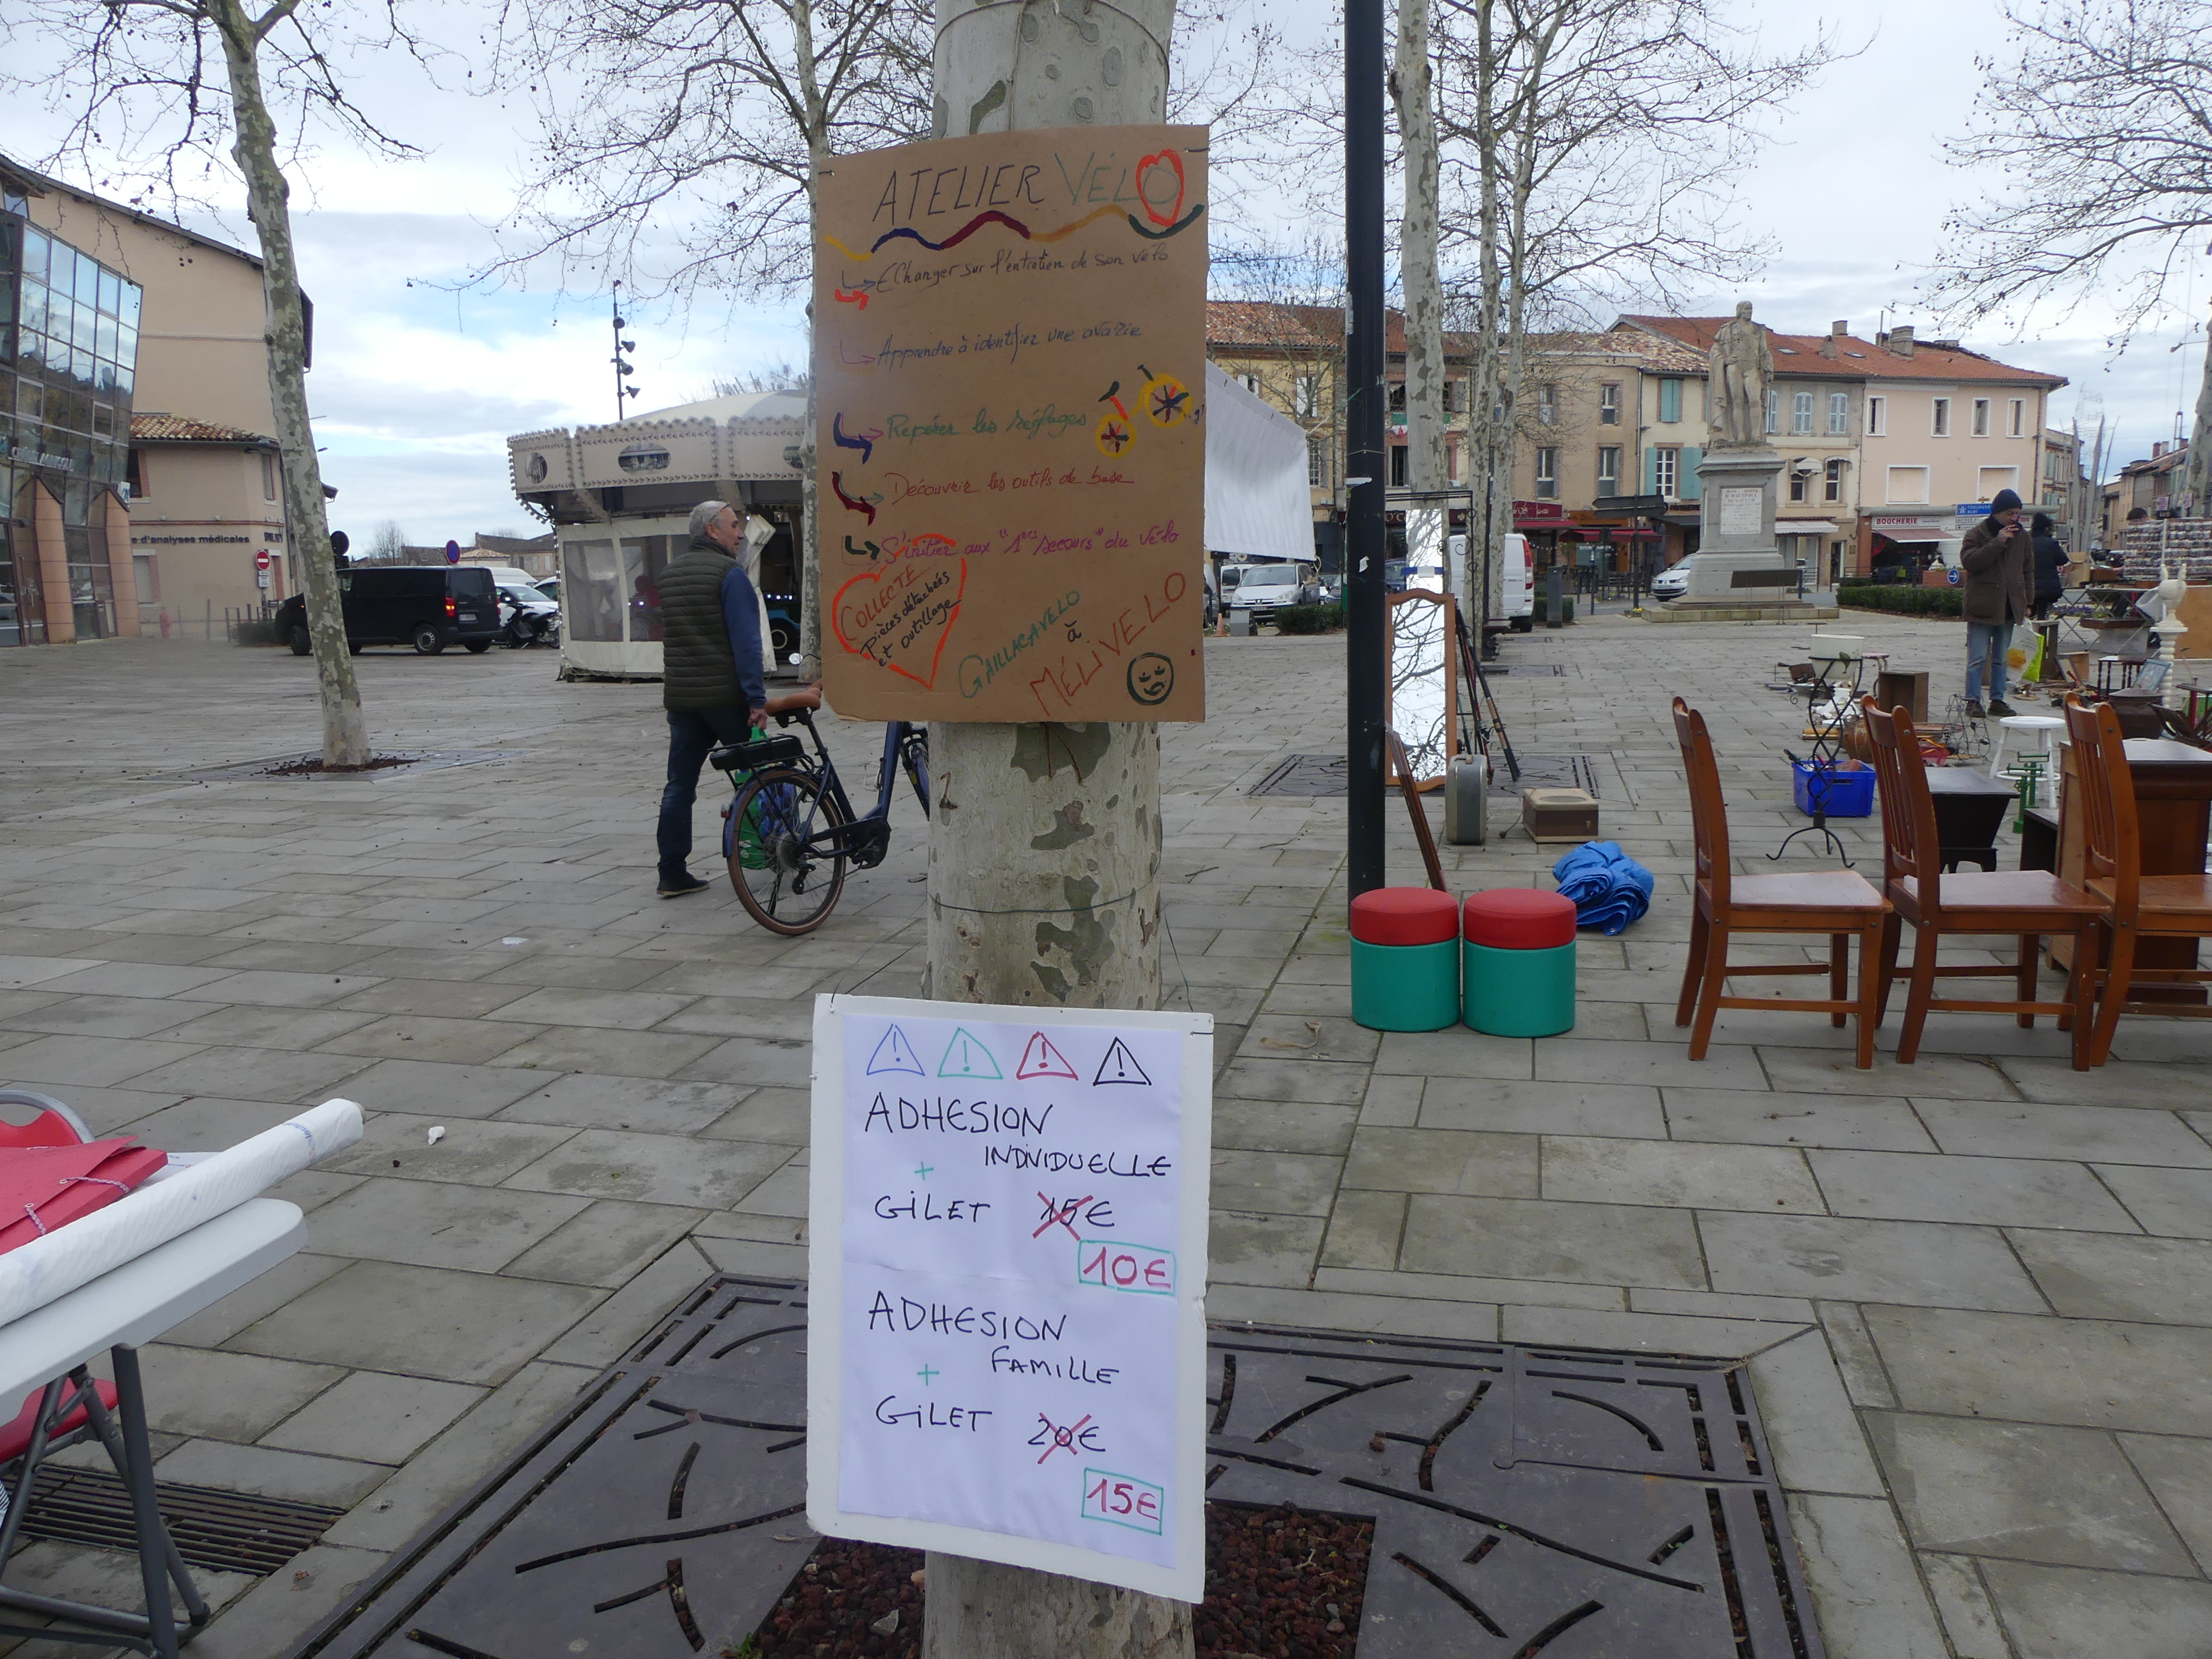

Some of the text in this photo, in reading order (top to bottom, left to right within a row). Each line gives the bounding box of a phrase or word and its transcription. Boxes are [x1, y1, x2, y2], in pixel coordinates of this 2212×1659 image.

[873, 165, 1045, 227] ATELIER
[1071, 250, 1087, 269] de
[878, 334, 951, 372] Apprendre
[958, 336, 967, 353] à
[974, 322, 1040, 365] identifier
[1082, 322, 1142, 339] avarie
[972, 408, 998, 434] les
[988, 470, 1006, 492] les
[1013, 468, 1053, 488] outils
[1059, 468, 1083, 486] de
[1086, 466, 1134, 485] base
[140, 535, 196, 545] d'analyses
[199, 535, 249, 543] médicales
[964, 542, 991, 555] aux
[1105, 530, 1129, 550] du
[879, 643, 893, 667] et
[865, 1092, 1053, 1136] ADHESION
[869, 1290, 1066, 1341] ADHESION
[991, 1345, 1119, 1384] FAMILLE
